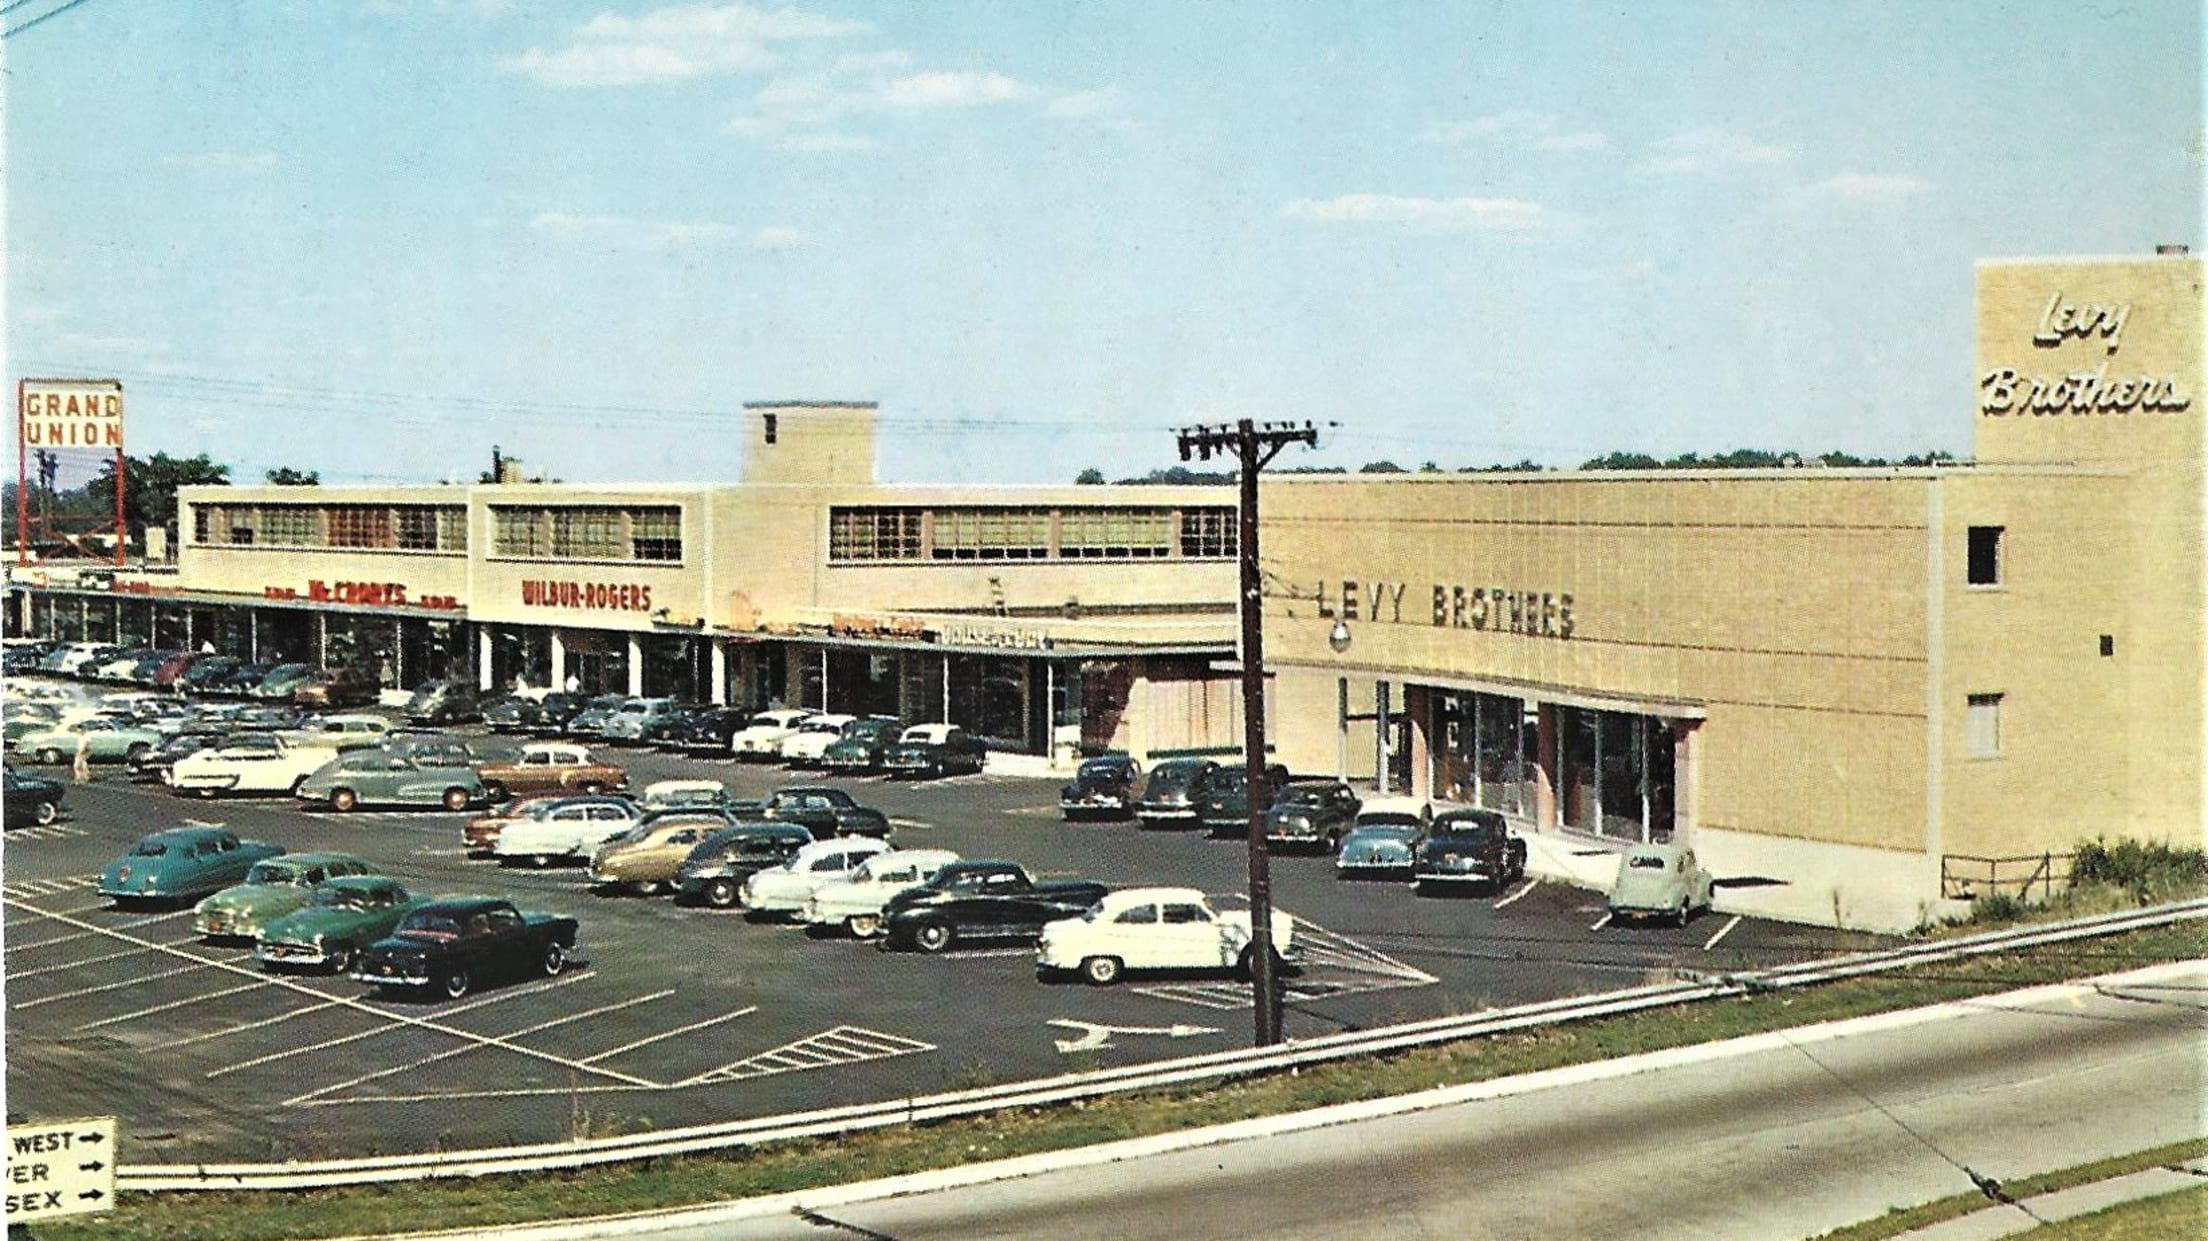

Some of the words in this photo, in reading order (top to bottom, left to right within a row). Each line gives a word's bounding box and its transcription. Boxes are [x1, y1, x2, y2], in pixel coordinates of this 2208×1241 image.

[2032, 288, 2130, 355] Levy
[26, 392, 118, 417] GRAND
[1981, 361, 2191, 417] Brothers
[27, 421, 121, 445] UNION
[522, 580, 651, 611] WILBUR-ROGERS
[1318, 580, 1406, 621] LEVY
[1433, 584, 1574, 639] BROTHERS
[12, 1131, 74, 1156] WEST
